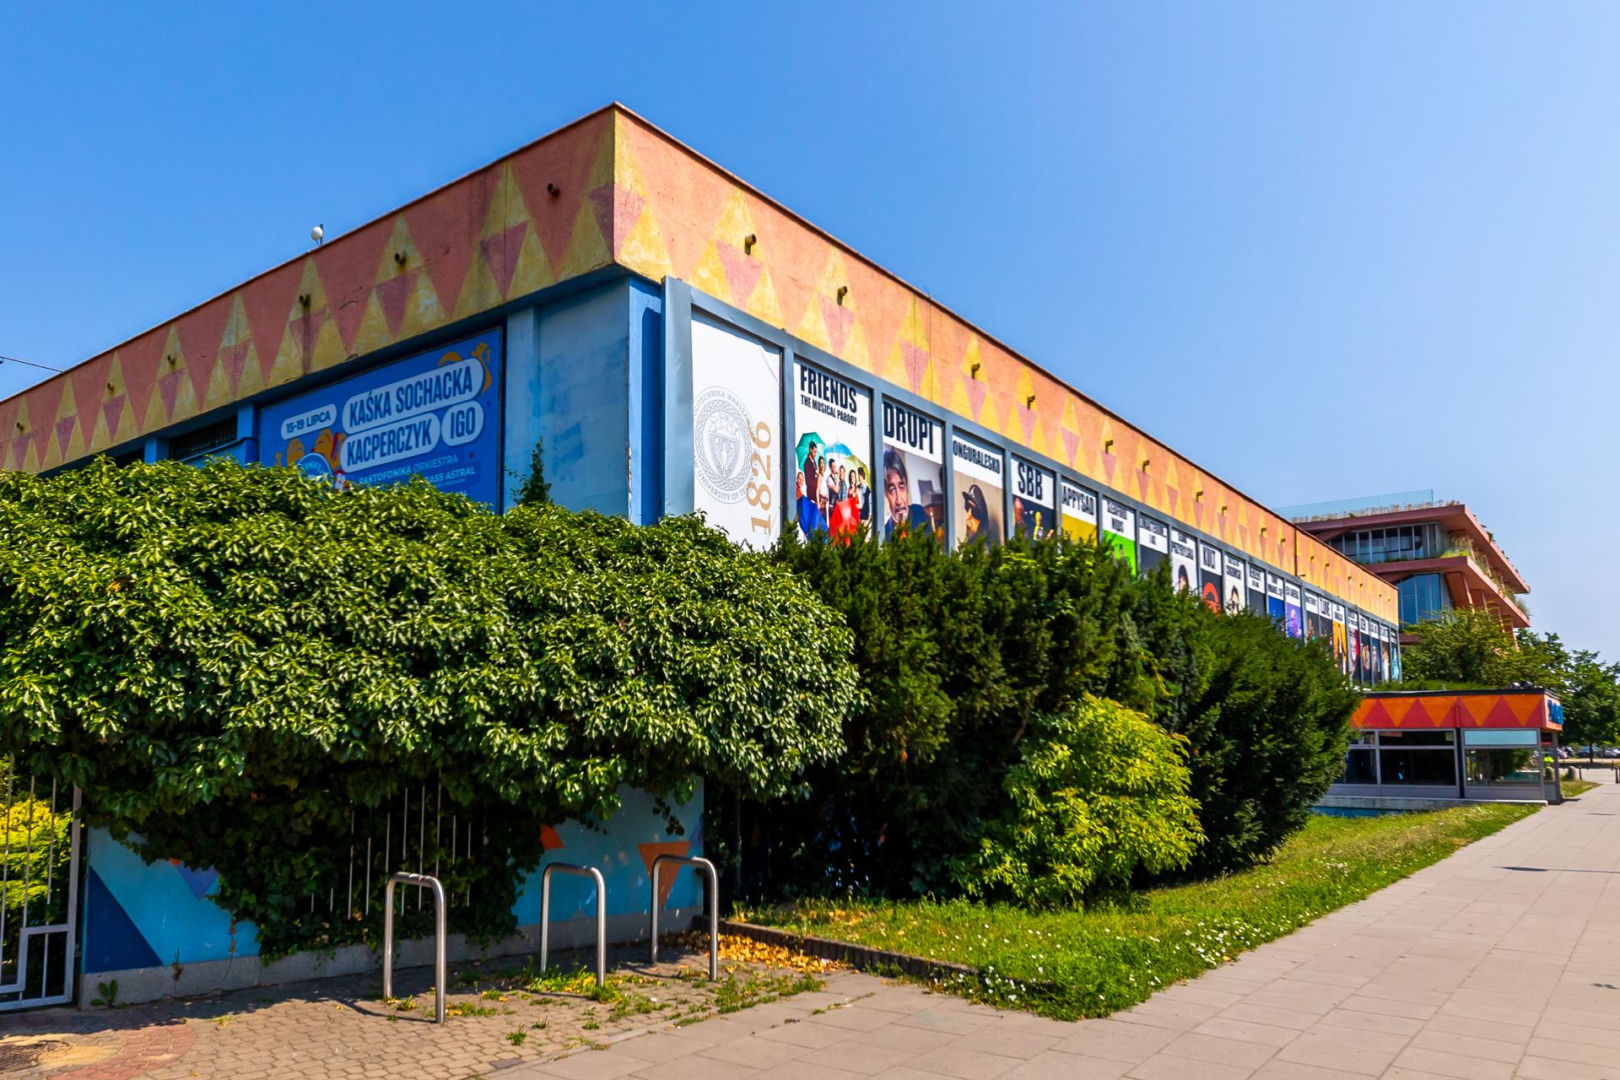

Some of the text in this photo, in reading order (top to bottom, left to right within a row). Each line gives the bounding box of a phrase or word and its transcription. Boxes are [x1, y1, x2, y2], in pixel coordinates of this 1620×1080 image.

[349, 365, 473, 428] KAŚKA SOCHACKA
[800, 365, 858, 413] FRIENDS
[801, 394, 858, 427] THE MUSICAL PARODY
[286, 411, 331, 434] 15-19 LIPCA
[347, 418, 433, 467] KACPERCZYK
[450, 406, 476, 439] IGO
[883, 401, 934, 455] DRUPI
[746, 421, 771, 536] 1826
[1017, 462, 1043, 500] SBB
